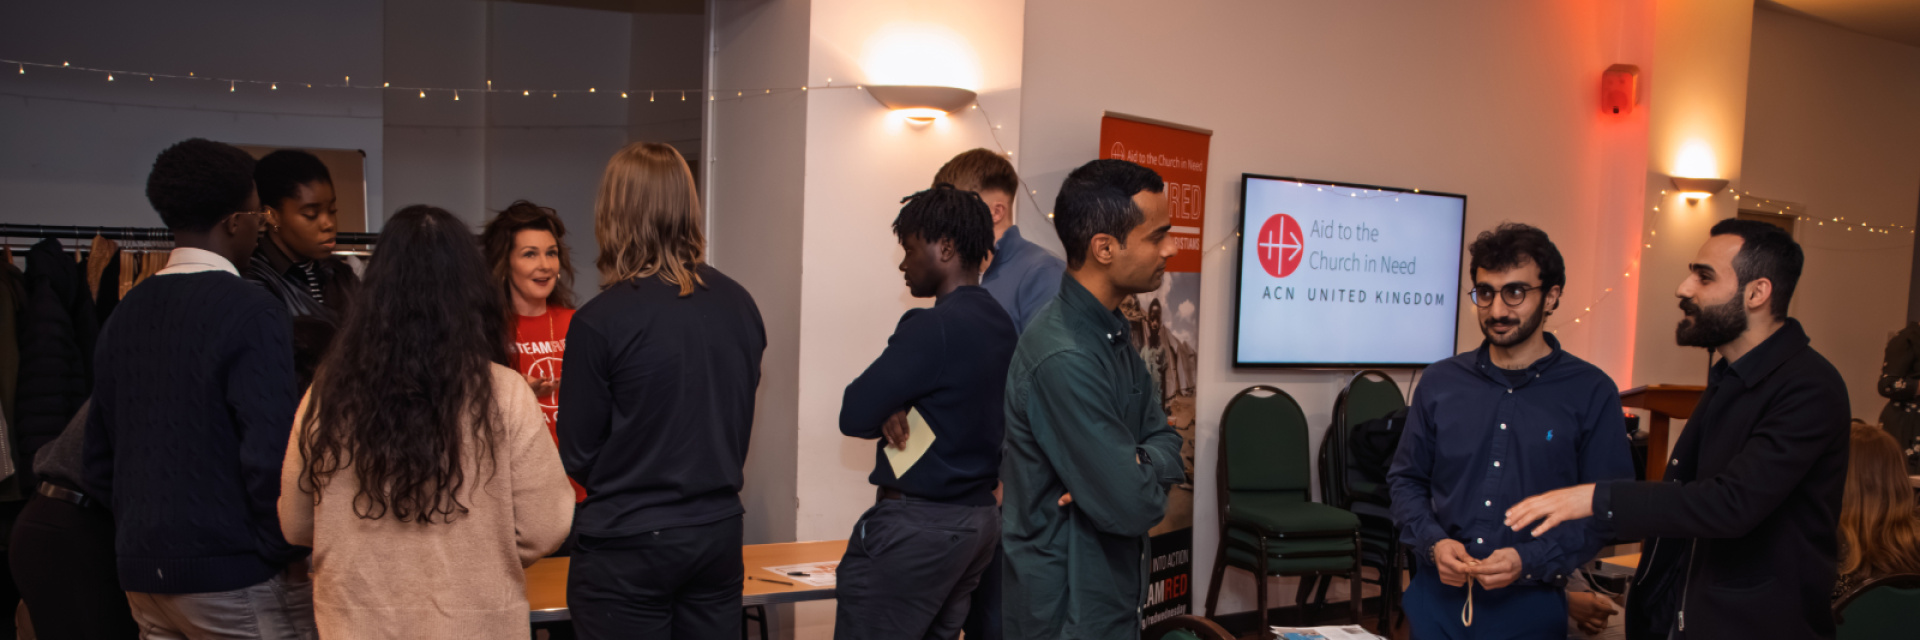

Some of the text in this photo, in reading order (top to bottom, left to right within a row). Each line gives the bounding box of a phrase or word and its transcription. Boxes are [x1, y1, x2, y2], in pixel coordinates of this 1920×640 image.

[1127, 149, 1203, 172] Aid to the Church in Need
[1164, 181, 1201, 220] RED
[1310, 219, 1379, 242] Aid to the
[1174, 236, 1200, 251] RISTIANS
[1309, 250, 1416, 275] Church in Need
[1262, 285, 1445, 306] ACN UNITED KINGDOM
[1143, 573, 1188, 610] AMRED
